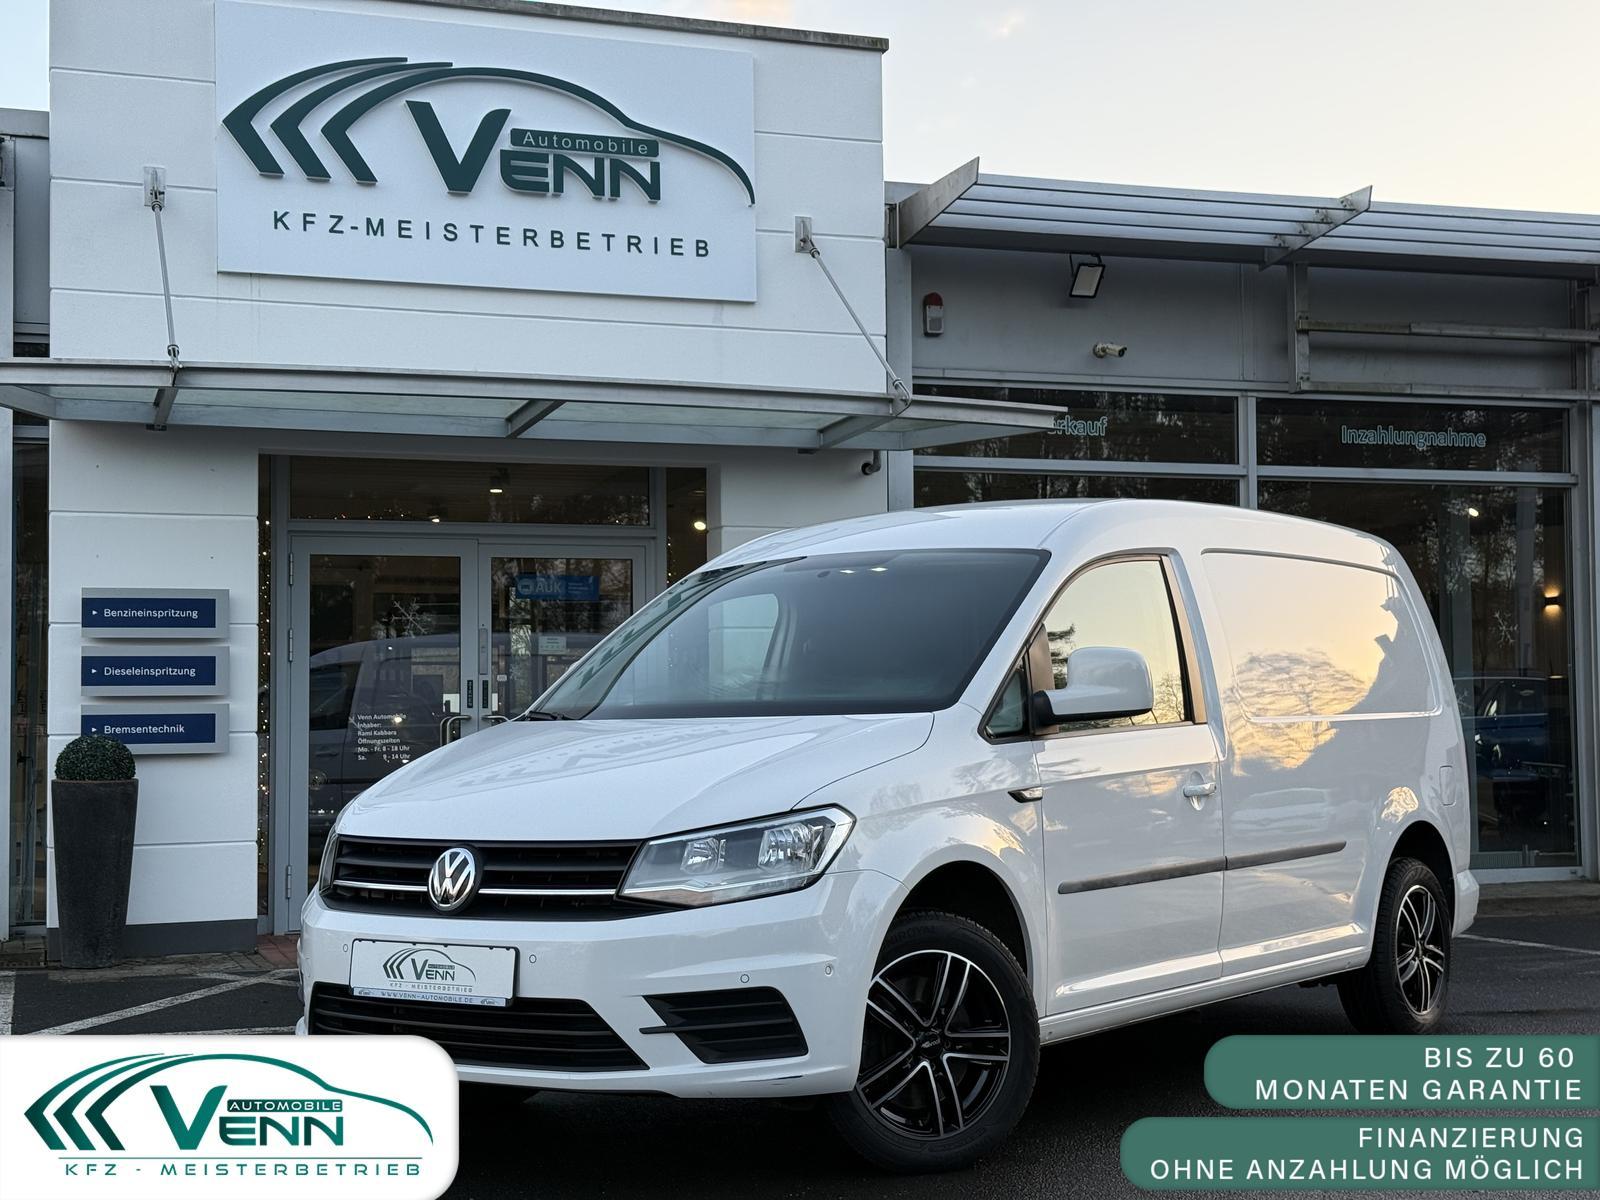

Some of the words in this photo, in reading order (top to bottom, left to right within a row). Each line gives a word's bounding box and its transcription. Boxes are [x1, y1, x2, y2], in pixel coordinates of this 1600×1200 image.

[404, 99, 662, 202] VENN
[522, 130, 650, 155] Automobile
[273, 210, 711, 257] KFZ-MEISTERBETRIEB
[1341, 425, 1487, 449] Inzahlungnahme
[103, 608, 199, 619] Benzineinspritzung
[103, 666, 197, 677] Dieseleinspritzung
[103, 724, 185, 734] Bremsentechnik
[411, 958, 455, 982] VENN
[381, 992, 473, 1003] WWW.VENN-AUTOMOBILE.DE
